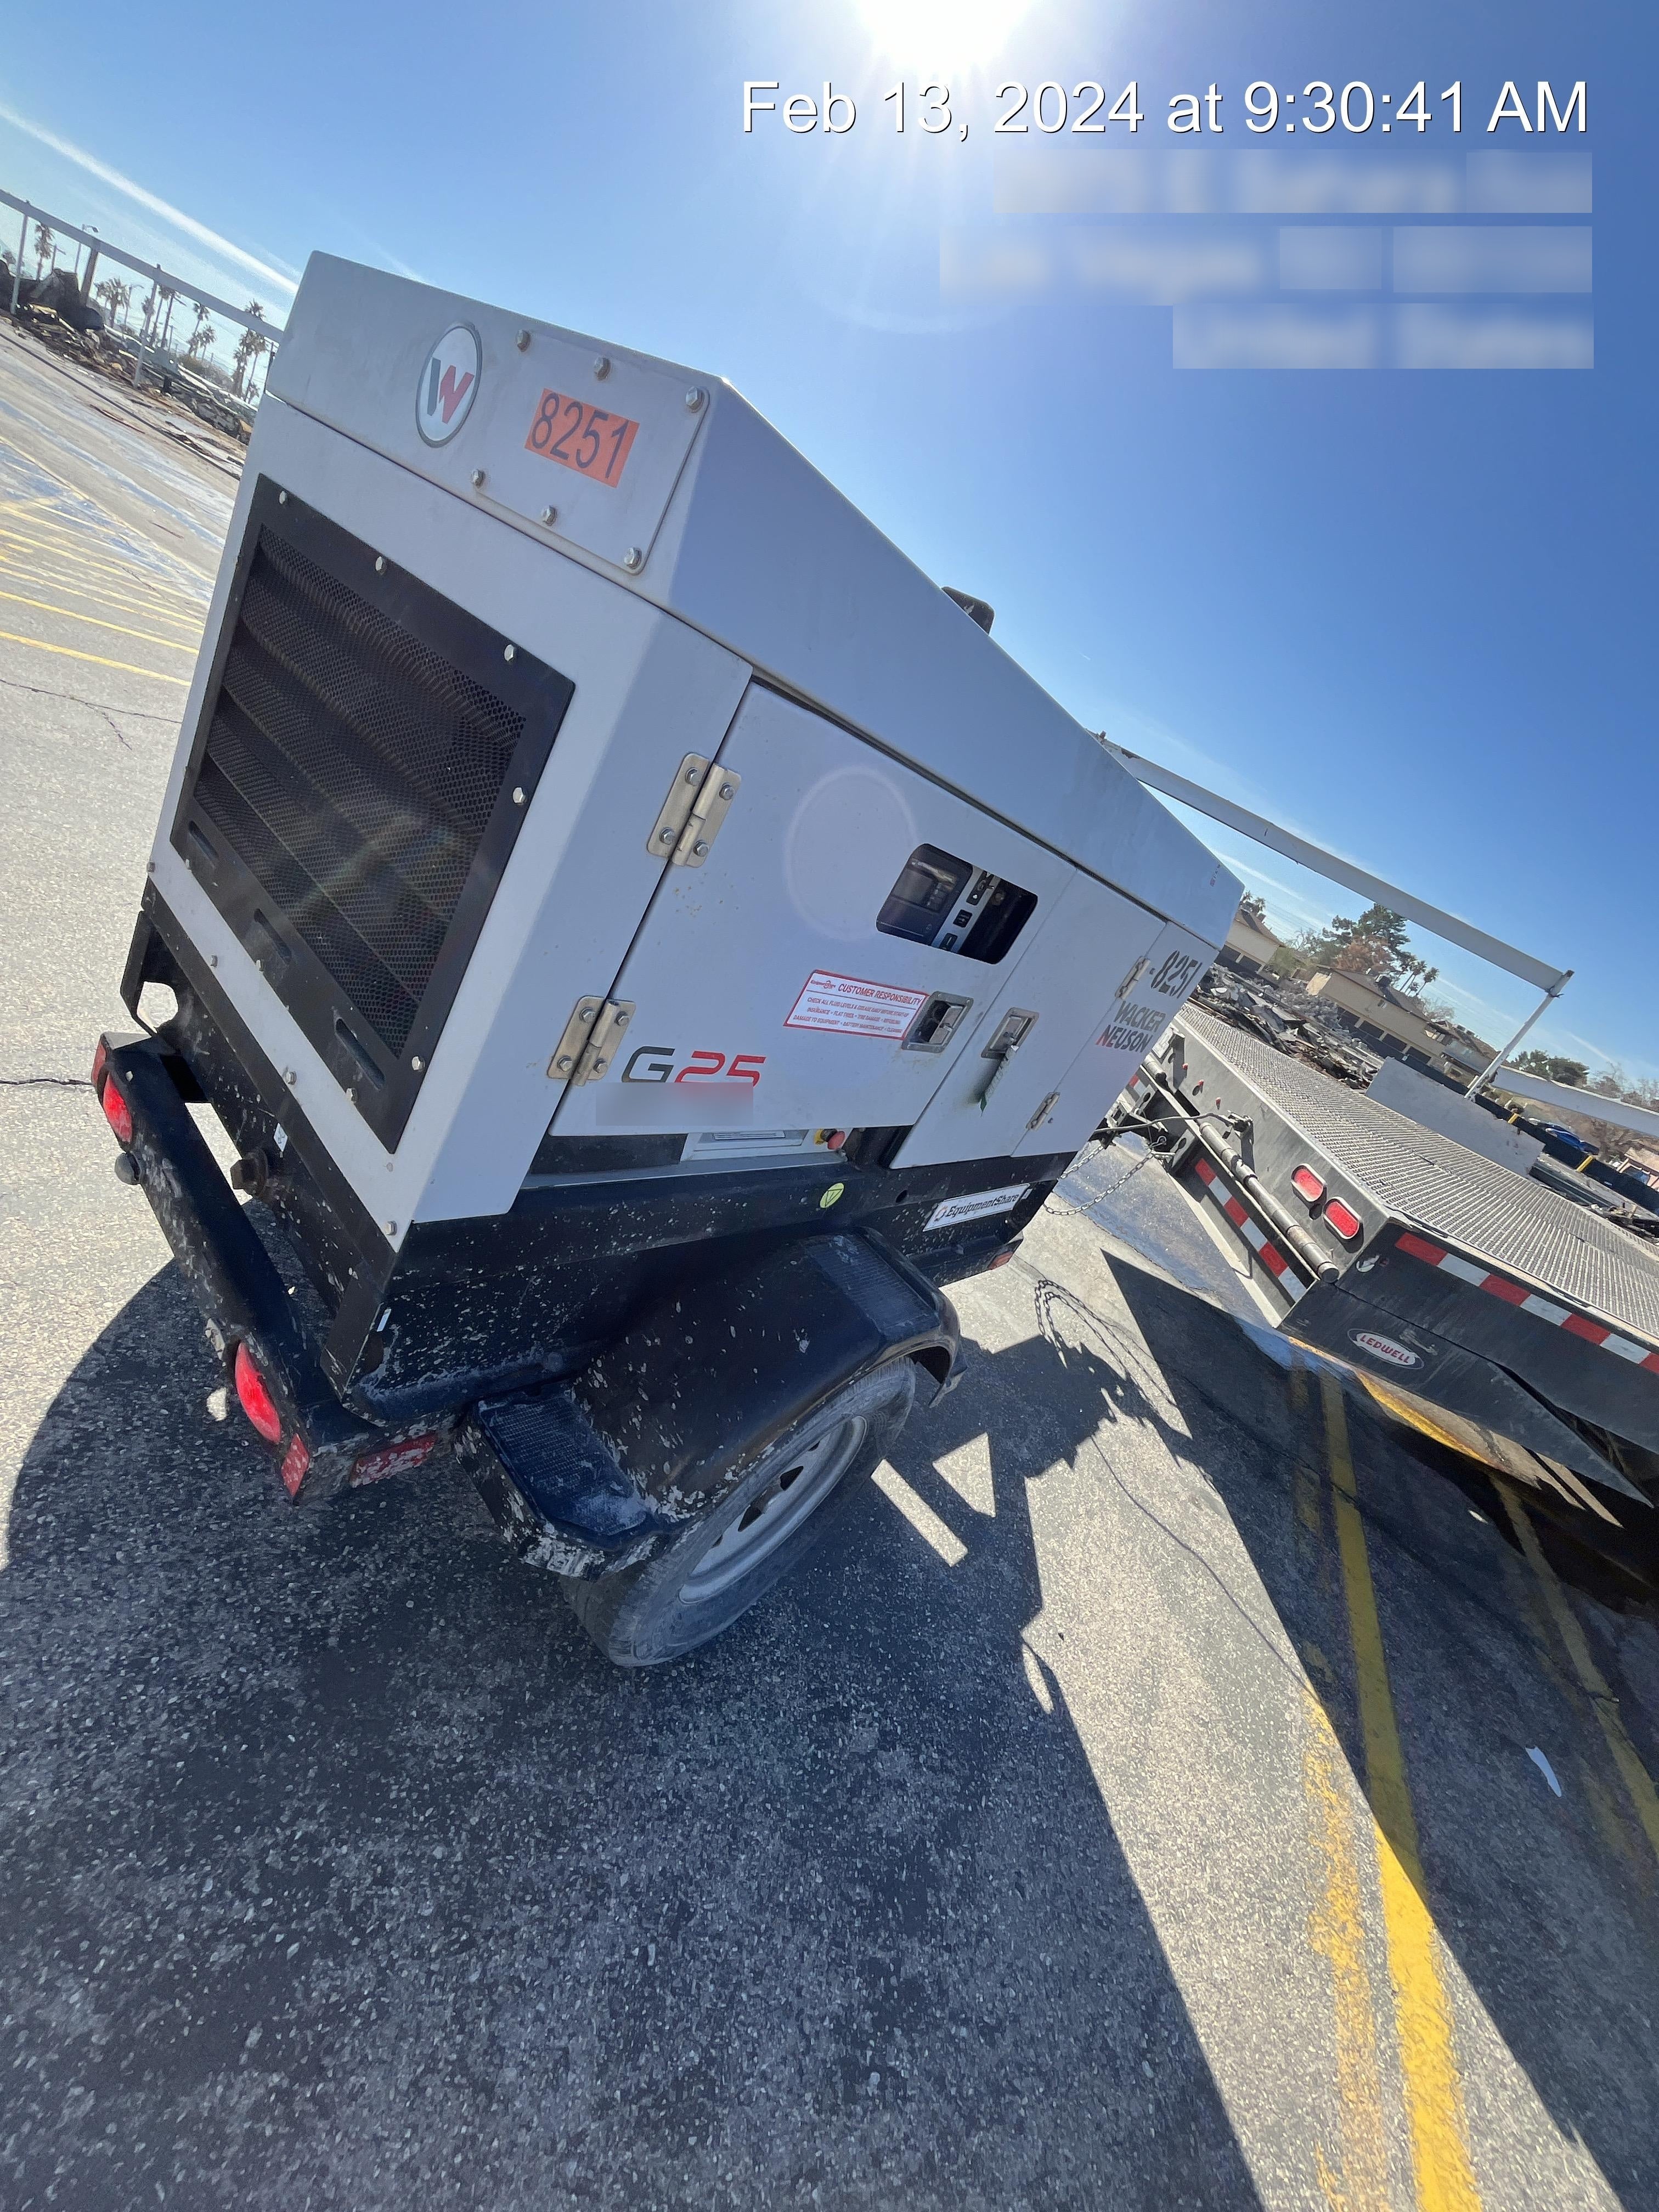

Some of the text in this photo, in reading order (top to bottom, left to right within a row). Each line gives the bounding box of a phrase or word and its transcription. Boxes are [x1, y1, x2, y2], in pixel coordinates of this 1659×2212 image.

[531, 392, 629, 478] 8251
[1150, 950, 1203, 999] 8251
[838, 983, 875, 997] CUSTOMER
[874, 991, 922, 1006] RESPONSIBILITY
[1114, 1001, 1166, 1032] WACKER
[1096, 1024, 1153, 1053] NEUSON
[621, 1046, 766, 1087] G25
[946, 1193, 1019, 1218] EquipmentShare
[1360, 1335, 1410, 1363] LEDWELL
